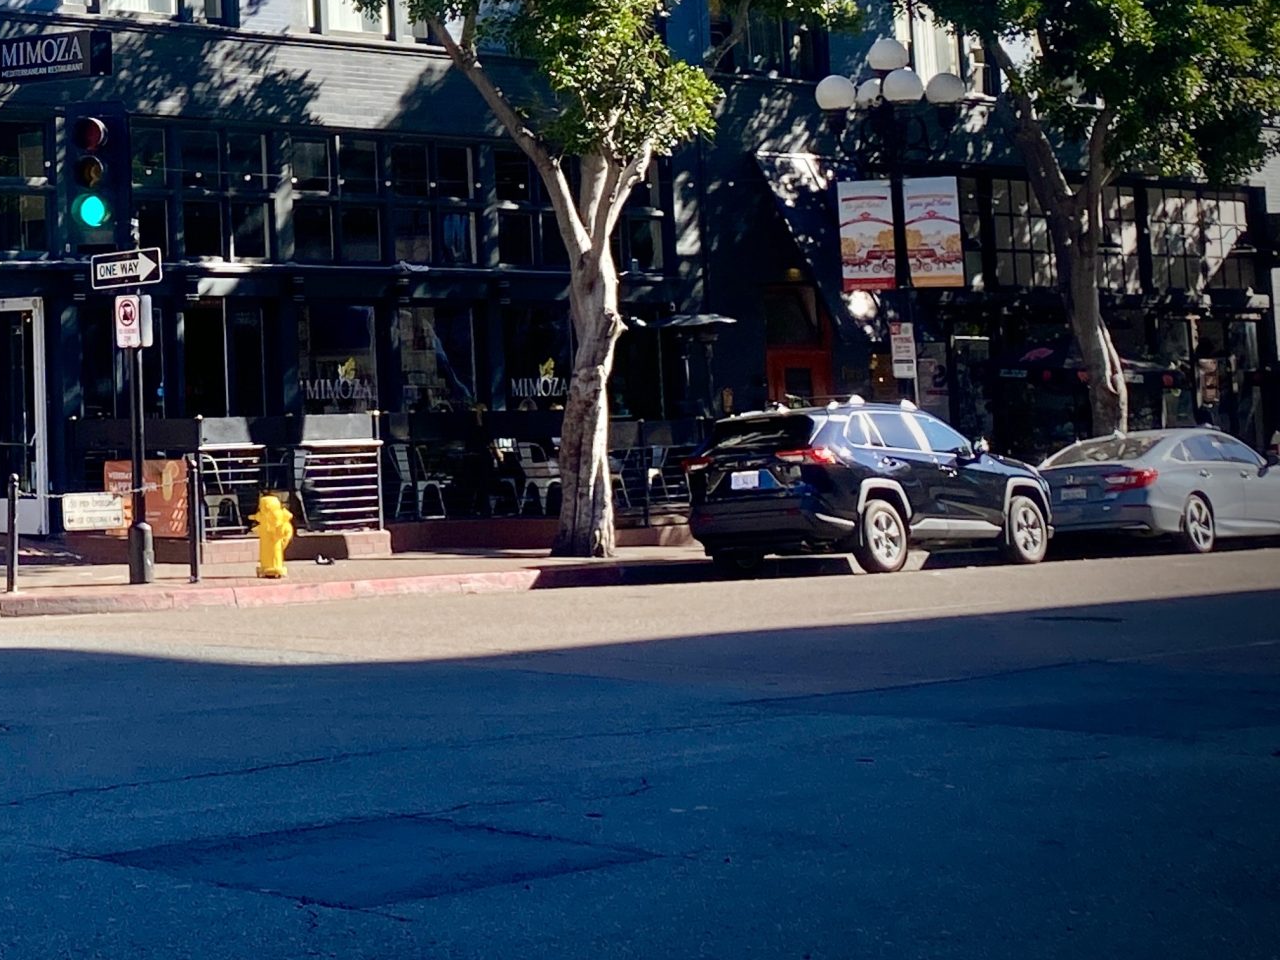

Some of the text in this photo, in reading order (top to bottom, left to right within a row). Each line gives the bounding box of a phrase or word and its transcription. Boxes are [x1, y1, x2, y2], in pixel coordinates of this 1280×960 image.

[1, 36, 84, 68] MIMOZA
[1, 62, 84, 78] MEDITERRANEAN RESTAURANT
[99, 261, 140, 278] ONE WAY
[306, 378, 373, 400] MIMOZA
[511, 377, 568, 397] MIMOZA
